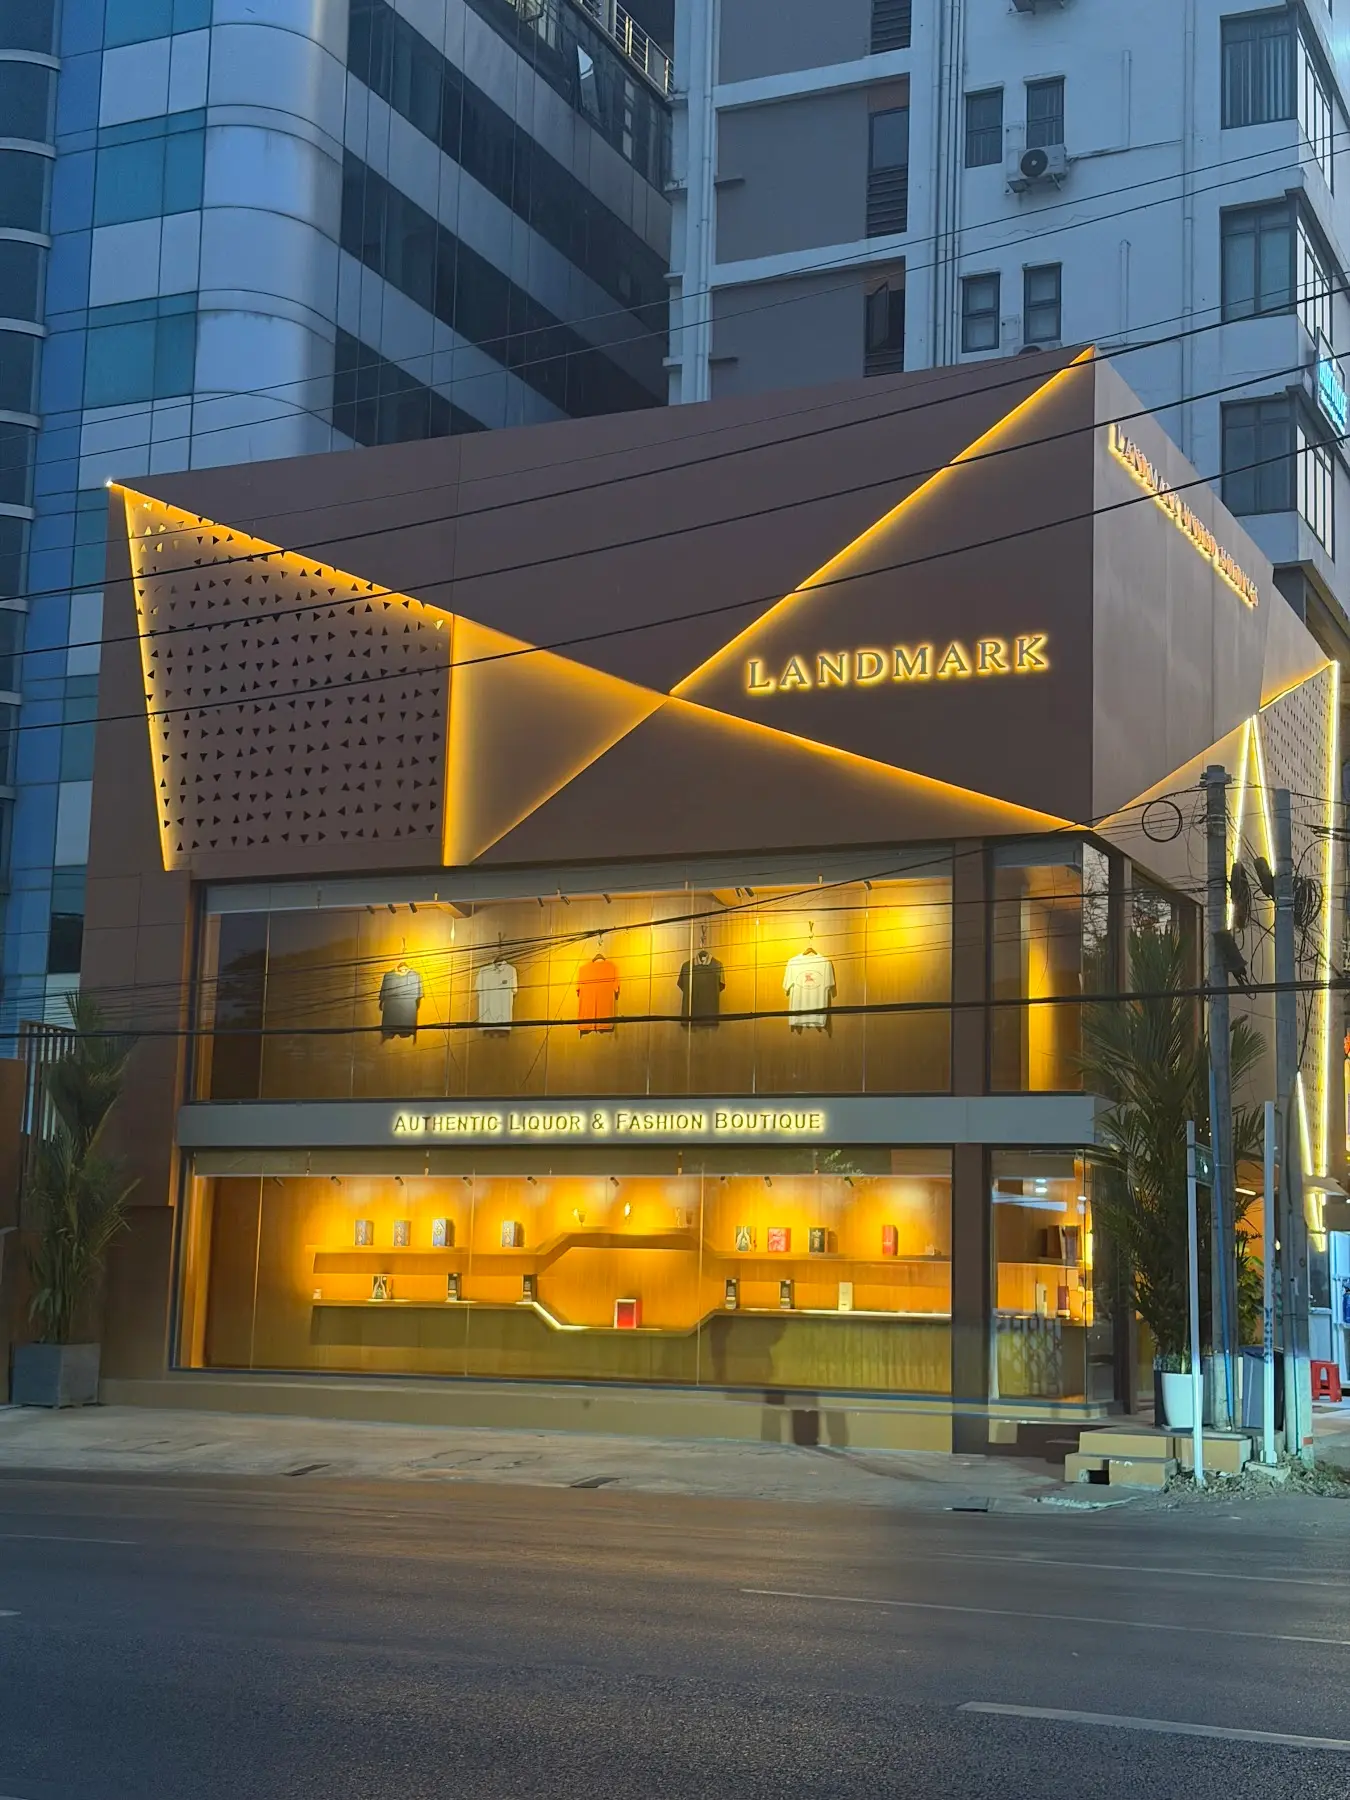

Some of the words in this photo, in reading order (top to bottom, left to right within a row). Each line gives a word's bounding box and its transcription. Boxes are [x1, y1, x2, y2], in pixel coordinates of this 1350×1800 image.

[747, 635, 1048, 690] LANDMARK
[393, 1114, 499, 1132] AUTHENTIC
[509, 1113, 581, 1131] LIQUOR
[591, 1112, 605, 1130] &
[615, 1112, 704, 1130] FASHION
[714, 1111, 821, 1130] BOUTIQUE
